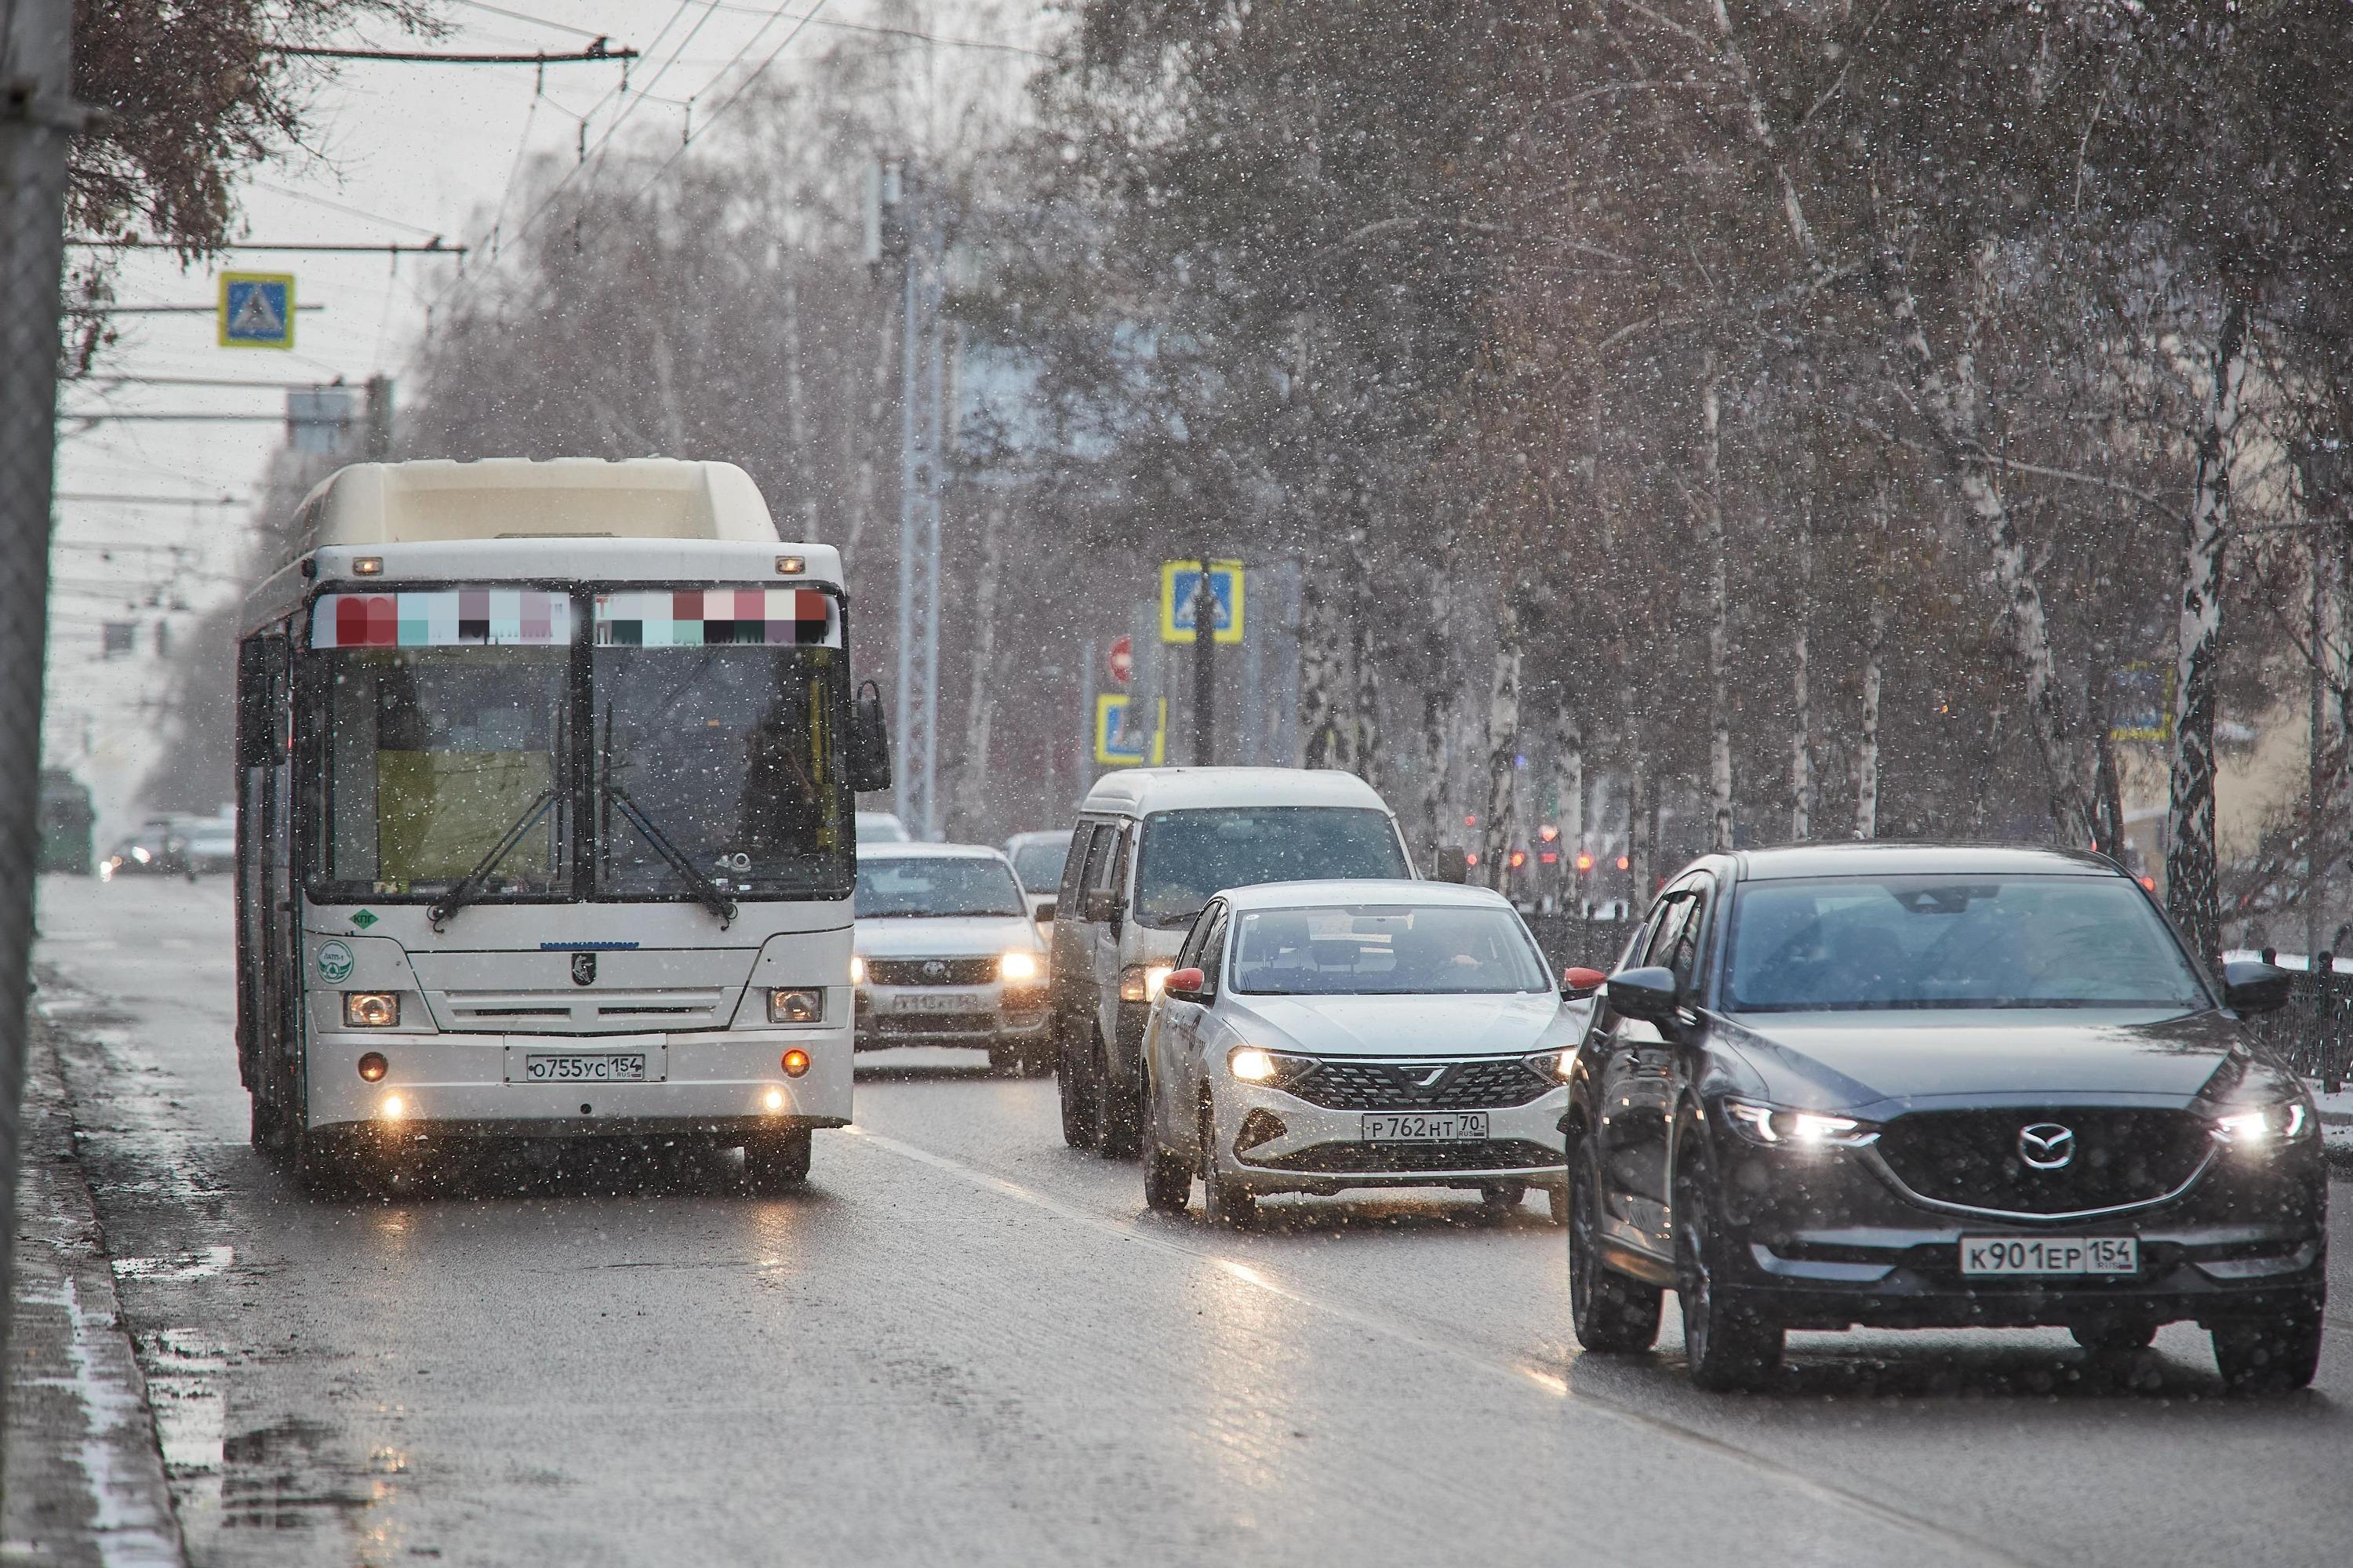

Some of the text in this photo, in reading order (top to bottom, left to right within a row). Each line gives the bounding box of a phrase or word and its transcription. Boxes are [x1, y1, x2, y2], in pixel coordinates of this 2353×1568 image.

[353, 915, 373, 923] КПГ
[533, 1057, 640, 1077] О755УС 154
[1373, 1115, 1479, 1137] Р762НТ 70
[1971, 1240, 2130, 1269] К901ЕР 154
